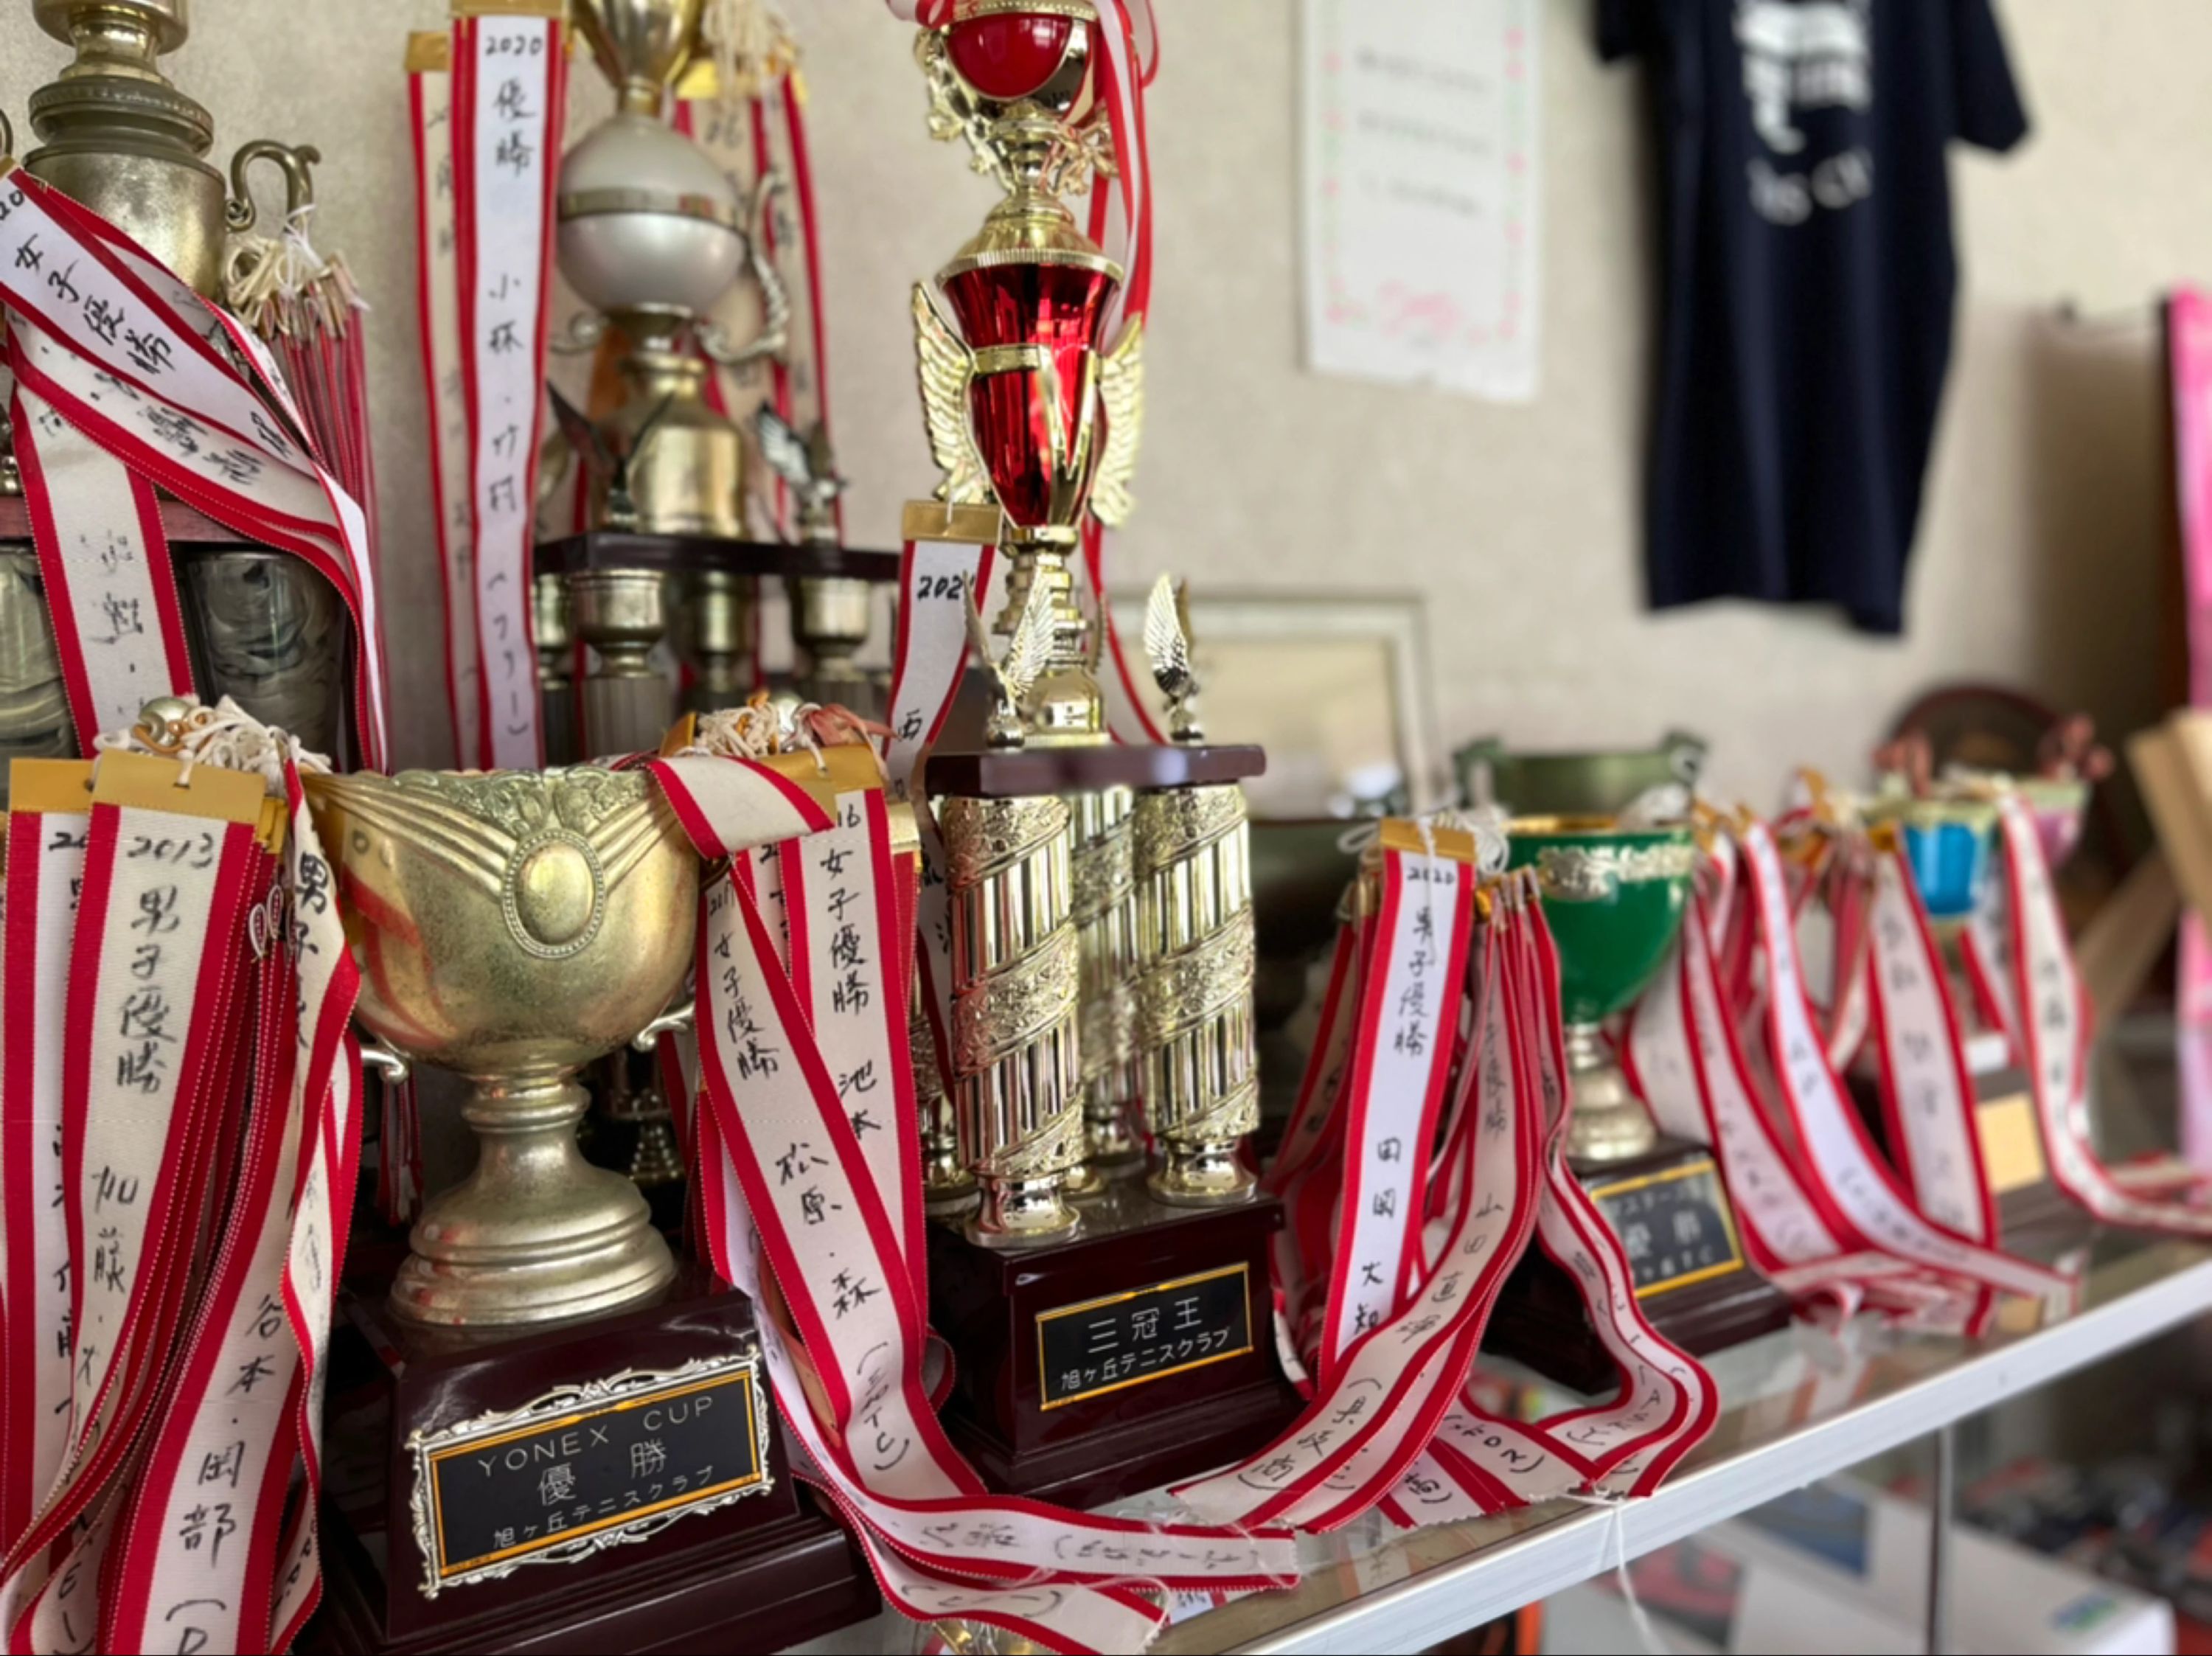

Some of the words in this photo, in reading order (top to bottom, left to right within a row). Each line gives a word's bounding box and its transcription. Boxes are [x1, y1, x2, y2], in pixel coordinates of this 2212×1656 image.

[485, 35, 544, 56] 2020
[14, 233, 176, 375] 女子優勝
[917, 574, 975, 600] 202
[126, 831, 215, 870] 2013
[819, 848, 870, 1016] 女子優勝
[115, 885, 181, 1096] 男子優勝
[714, 930, 779, 1081] 女子優勝
[1061, 1326, 1231, 1391] 旭ヶ丘テニスクラブ
[1088, 1295, 1203, 1354] 三冠王
[477, 1424, 611, 1478] YONEX
[642, 1395, 714, 1432] CUP
[536, 1437, 667, 1506] 優勝
[493, 1464, 714, 1549] 旭ヶ丘テニスクラブ
